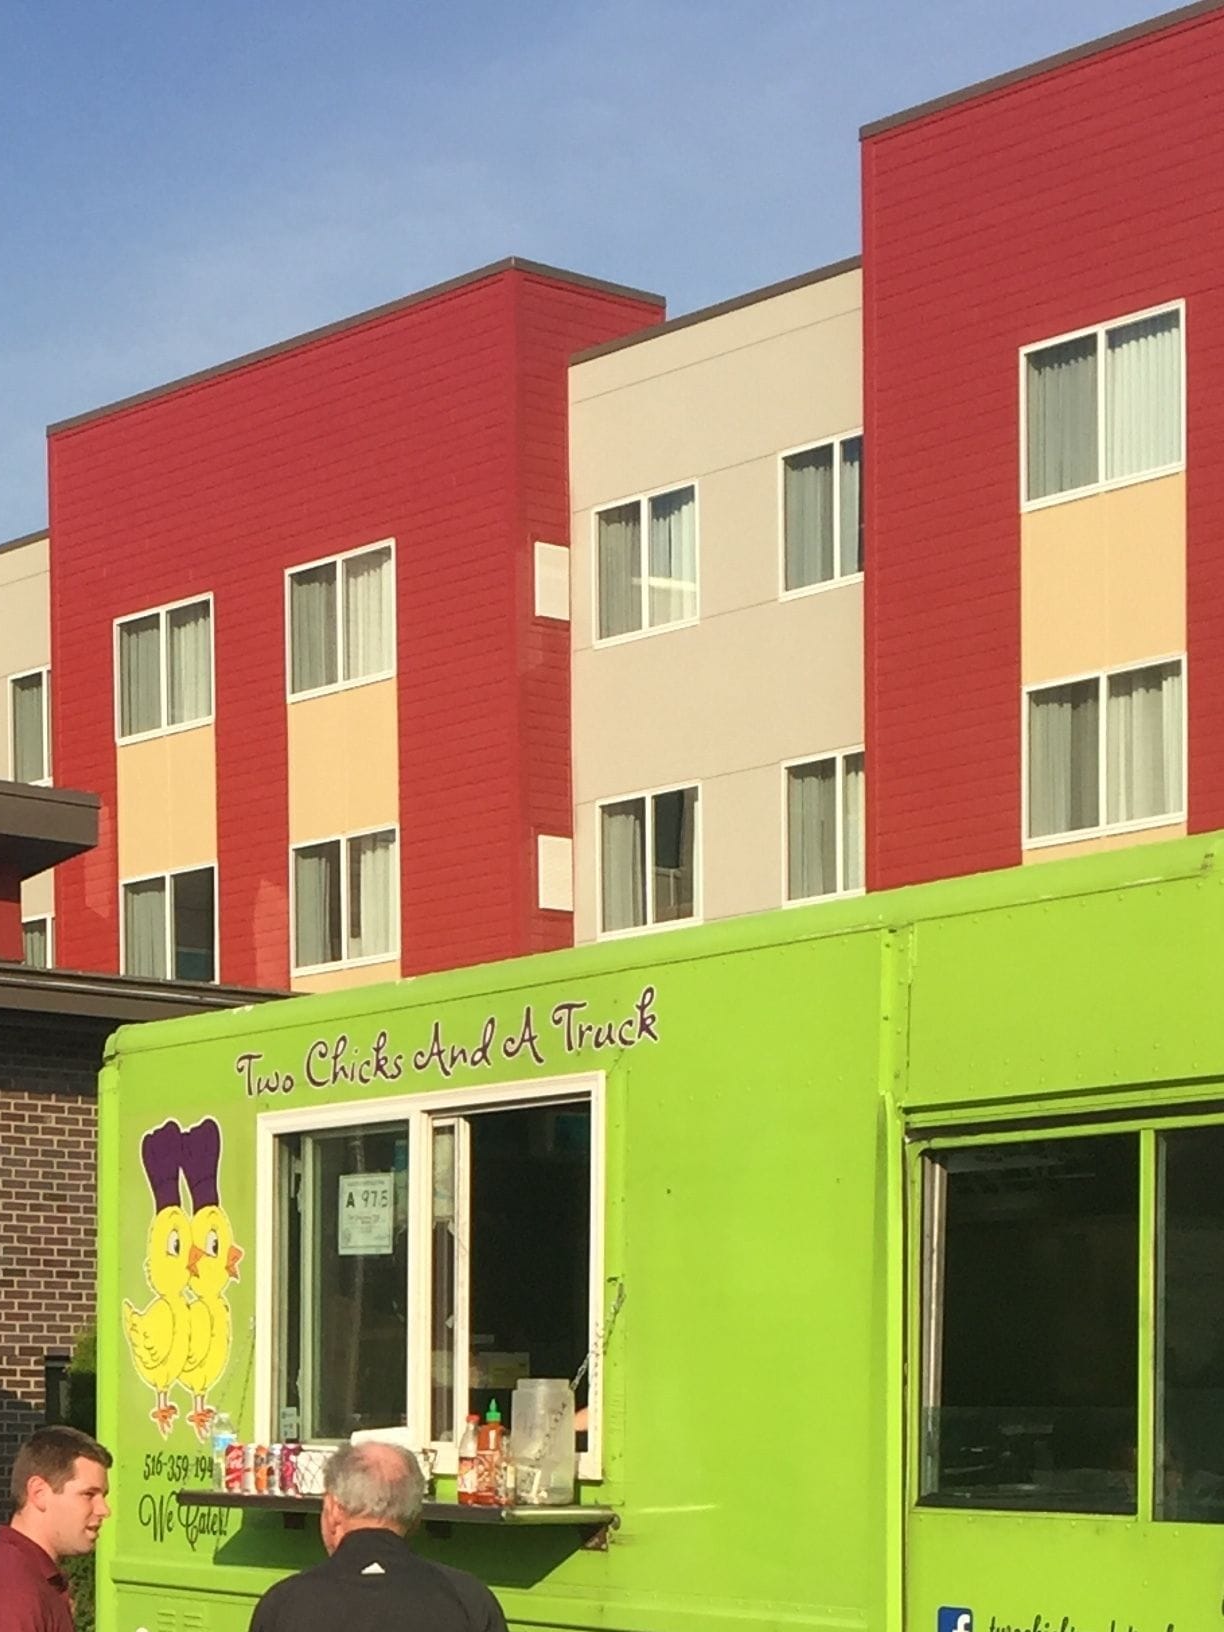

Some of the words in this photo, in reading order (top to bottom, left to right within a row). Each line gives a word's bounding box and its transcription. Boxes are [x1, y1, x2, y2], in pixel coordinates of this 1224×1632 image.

[236, 1053, 294, 1096] Two
[305, 1031, 403, 1088] Chicks
[413, 1017, 495, 1078] And
[503, 1006, 546, 1067] A
[551, 985, 660, 1053] Truck
[345, 1191, 355, 1208] A
[143, 1452, 214, 1482] 516-359-194
[139, 1494, 173, 1543] We
